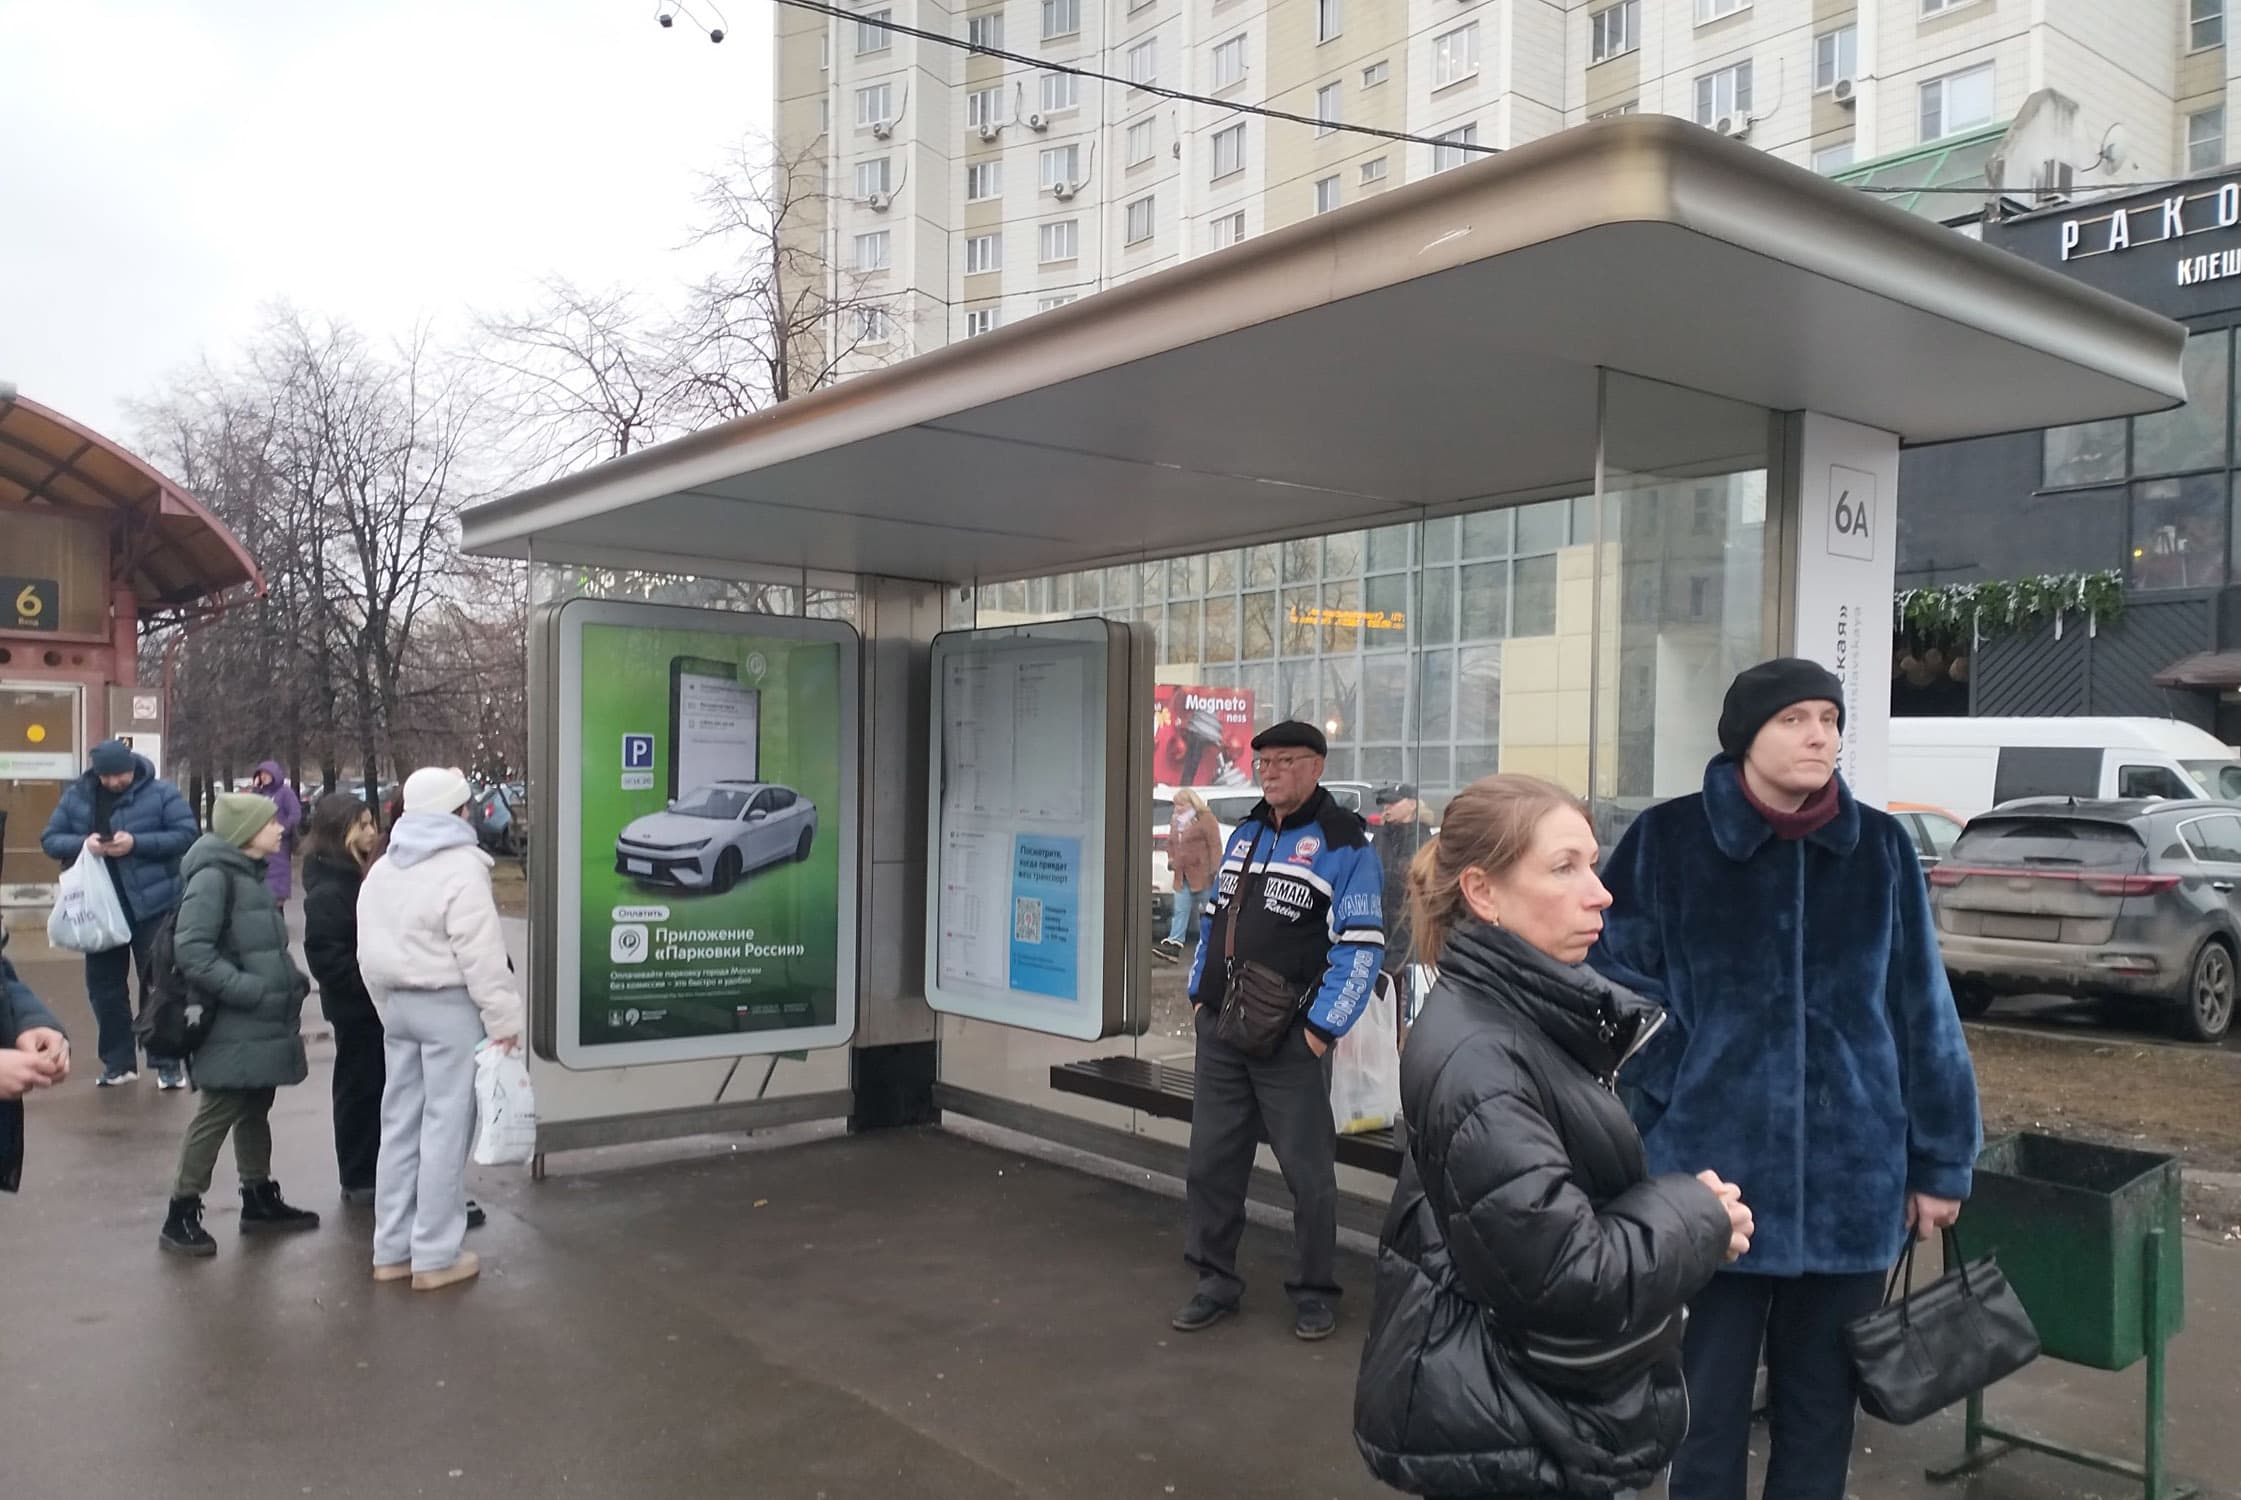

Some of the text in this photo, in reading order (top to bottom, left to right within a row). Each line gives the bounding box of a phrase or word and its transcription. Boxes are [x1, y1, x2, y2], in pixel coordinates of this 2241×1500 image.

[1835, 490, 1868, 538] 6А
[16, 585, 42, 617] 6
[1185, 694, 1246, 714] Magneto
[1226, 713, 1247, 723] ness
[633, 740, 647, 765] P
[1264, 876, 1313, 910] YAMAHA
[618, 909, 663, 918] Оплатить
[1264, 898, 1301, 922] Racing
[655, 928, 754, 944] Приложение
[655, 943, 805, 962] «Парковки России»
[1326, 949, 1374, 1027] RACING
